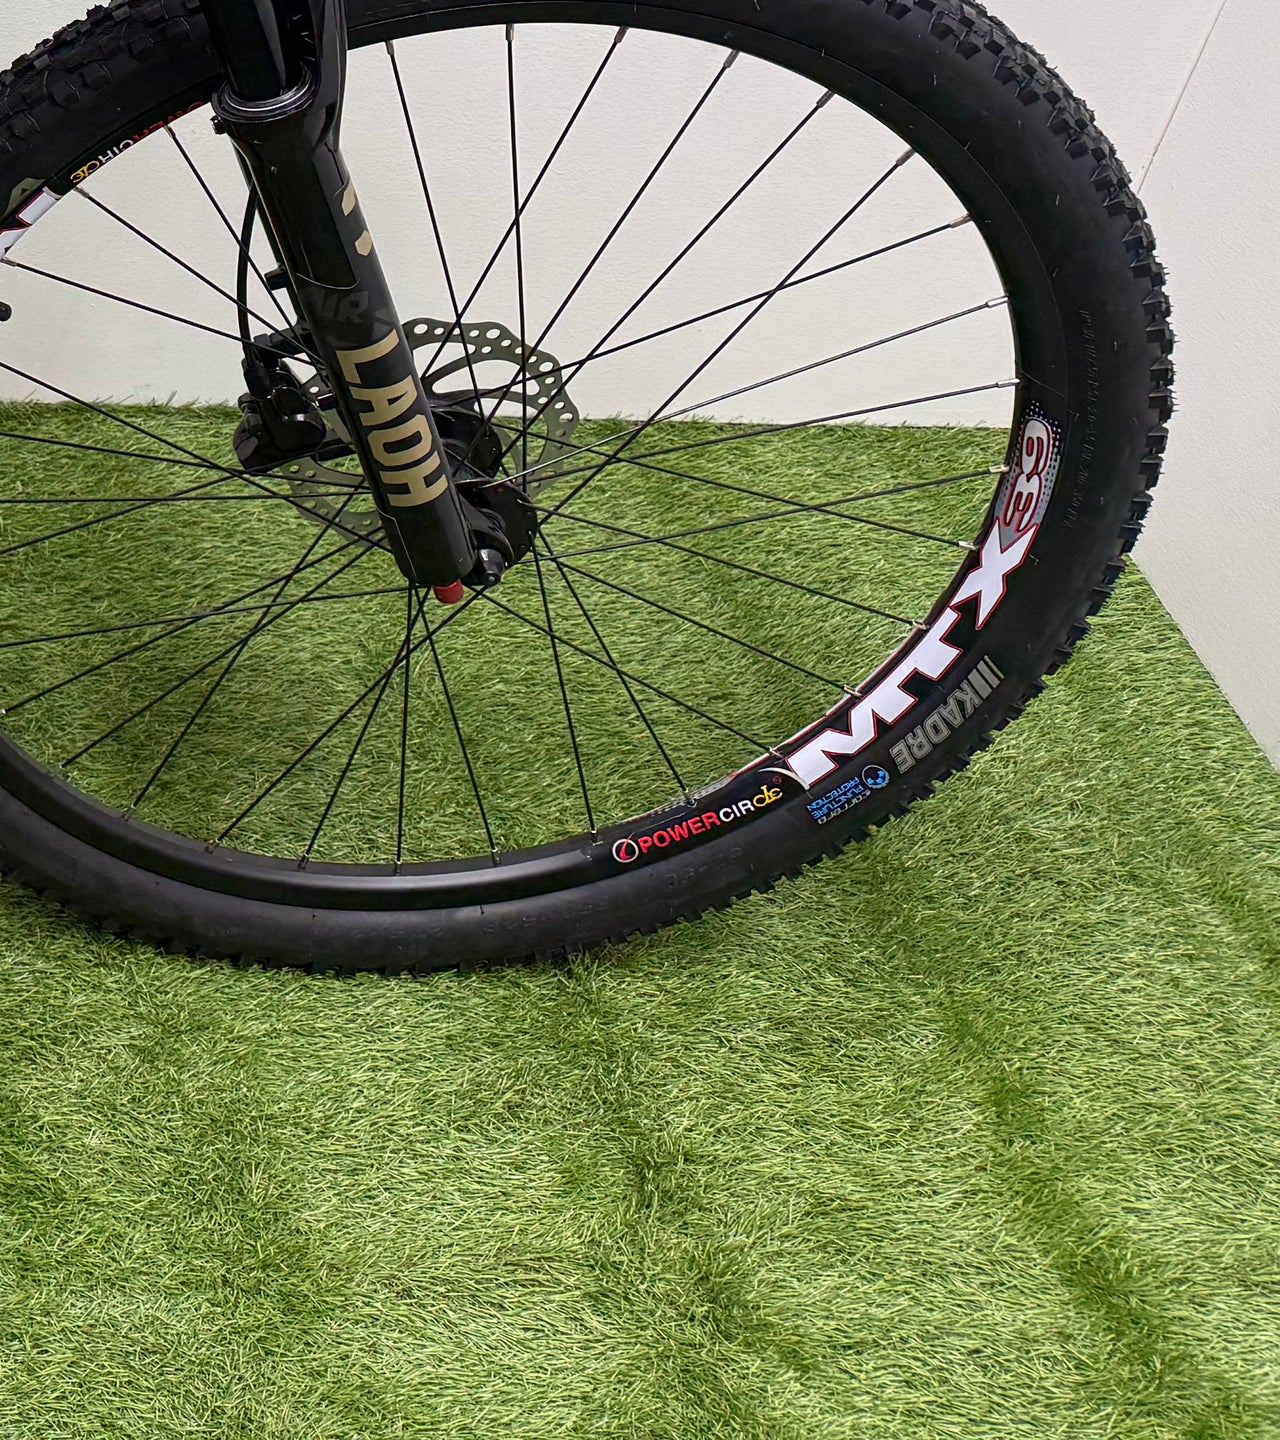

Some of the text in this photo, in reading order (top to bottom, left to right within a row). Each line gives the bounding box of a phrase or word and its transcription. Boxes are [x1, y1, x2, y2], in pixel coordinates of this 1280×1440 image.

[1002, 416, 1056, 534] 39
[786, 517, 1040, 787] MTX
[889, 679, 983, 775] KADRE
